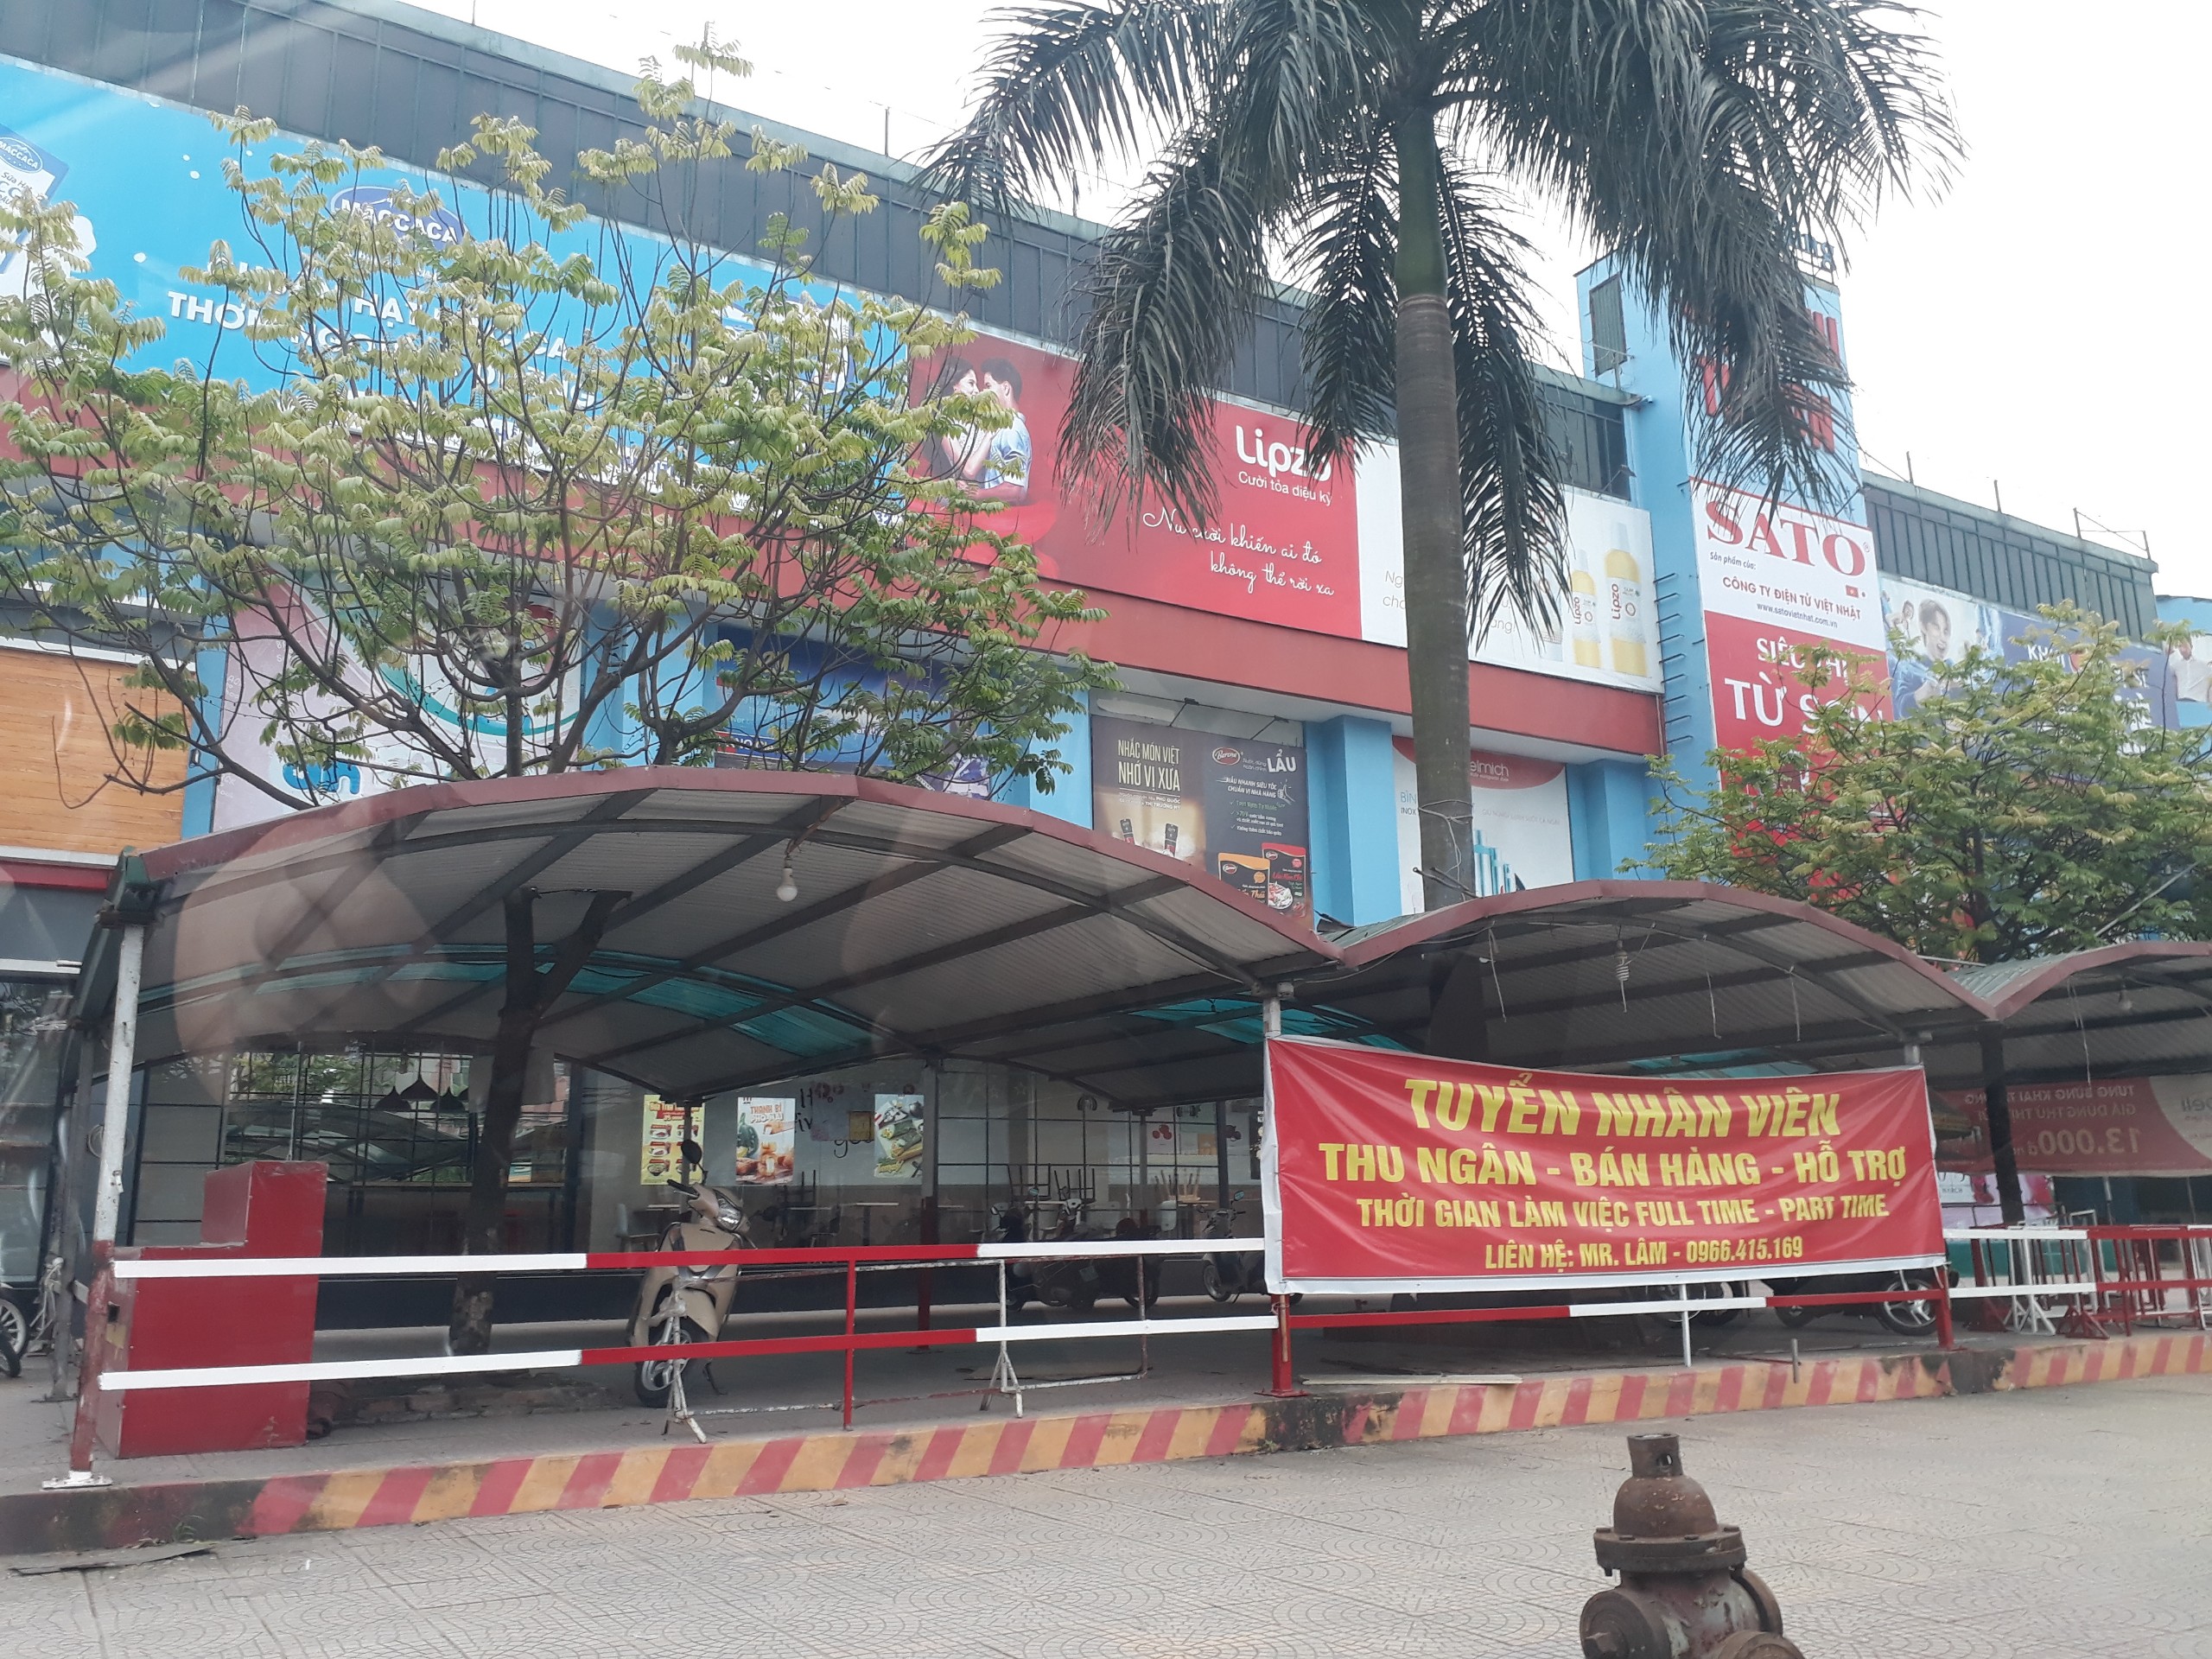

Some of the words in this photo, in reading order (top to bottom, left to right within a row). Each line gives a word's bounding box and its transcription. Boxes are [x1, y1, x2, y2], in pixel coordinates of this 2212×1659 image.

[0, 141, 39, 168] MACCACA
[1238, 471, 1268, 490] Cười
[1270, 478, 1289, 494] tỏa
[1293, 483, 1316, 502] diệu
[1230, 522, 1277, 555] khiến
[1281, 543, 1298, 560] ai
[1302, 541, 1322, 564] đó
[1706, 499, 1866, 577] SATO
[1211, 550, 1257, 594] không
[1262, 562, 1287, 587] thể
[1289, 575, 1312, 593] rời
[1315, 583, 1335, 597] xa
[1573, 596, 1582, 626] Lipzo
[1611, 583, 1622, 620] Lipzo
[1722, 575, 1757, 594] CÔNG
[1759, 585, 1770, 598] TY
[1774, 588, 1797, 606] ĐIỆN
[1814, 598, 1834, 615] VIỆT
[1836, 602, 1861, 621] NHẬT
[1724, 672, 1788, 727] TỪ
[1118, 737, 1141, 759] NHẮC
[1142, 742, 1161, 762] MÓN
[1162, 746, 1180, 766] VIỆT
[1268, 748, 1297, 772] LẨU
[1118, 760, 1141, 785] NHỚ
[1144, 765, 1155, 791] VỊ
[1158, 767, 1180, 791] XƯA
[1256, 780, 1267, 789] SIÊU
[1268, 782, 1277, 791] TỐC
[1404, 1072, 1581, 1136] TUYỂN
[1591, 1087, 1732, 1137] NHÂN
[1739, 1087, 1840, 1137] VIÊN
[1319, 1143, 1406, 1183] THU
[1416, 1142, 1537, 1185] NGÂN
[1570, 1146, 1650, 1186] BÁN
[1659, 1146, 1761, 1186] HÀNG
[1793, 1140, 1840, 1183] HỖ
[1847, 1146, 1907, 1186] TRỢ
[1357, 1192, 1425, 1227] THỜI
[1434, 1199, 1502, 1228] GIAN
[1508, 1195, 1568, 1228] LÀM
[1573, 1196, 1629, 1232] VIỆC
[1635, 1200, 1694, 1227] FULL
[1696, 1198, 1759, 1225] TIME
[1778, 1196, 1835, 1222] PART
[1840, 1194, 1890, 1218] TIME
[1485, 1239, 1534, 1269] LIÊN
[1541, 1238, 1574, 1273] HỆ:
[1580, 1243, 1619, 1268] MR.
[1624, 1237, 1667, 1267] LÂM
[1687, 1236, 1803, 1264] 0966.415.169
